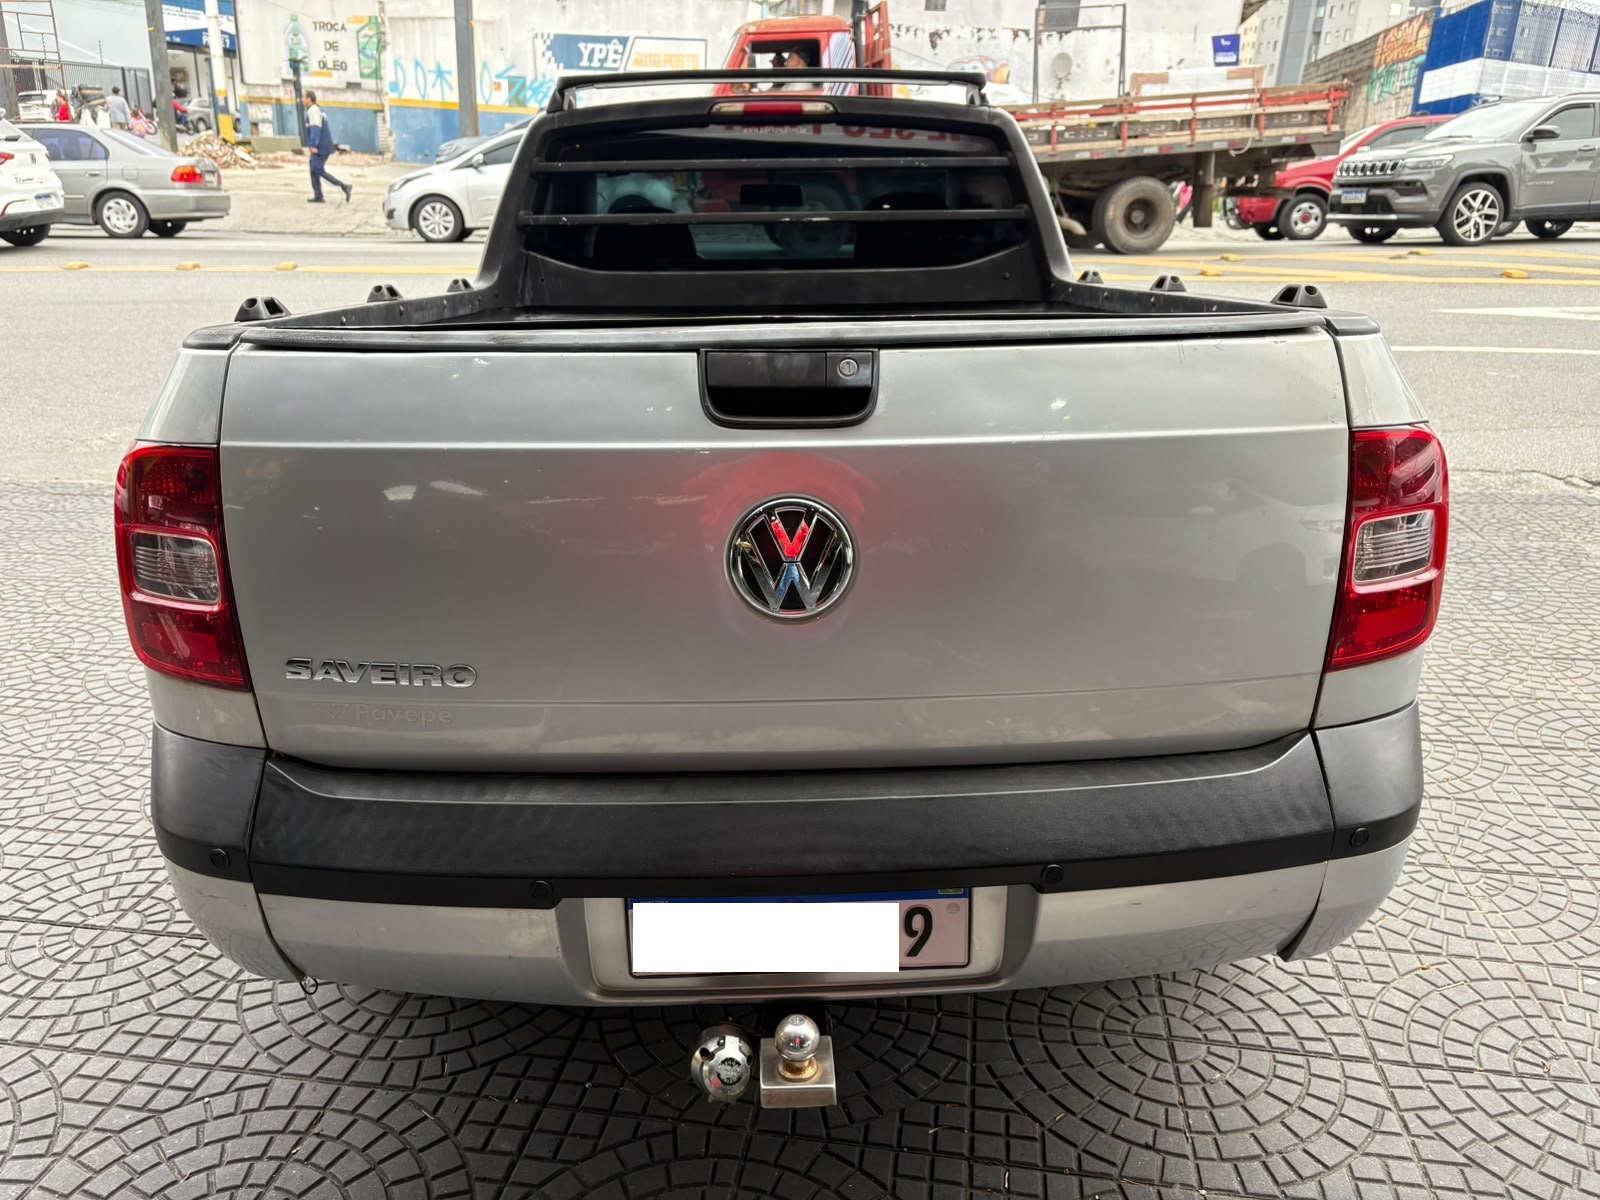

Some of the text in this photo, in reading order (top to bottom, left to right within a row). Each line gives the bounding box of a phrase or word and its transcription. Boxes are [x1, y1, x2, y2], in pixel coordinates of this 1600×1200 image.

[313, 21, 347, 32] TROCA
[324, 41, 339, 52] DE
[577, 38, 624, 68] YPÊ
[318, 55, 348, 71] ÓLEO
[632, 52, 701, 69] AUTO POSTO
[284, 657, 477, 688] SAVEIRO
[355, 703, 452, 727] Pavepe
